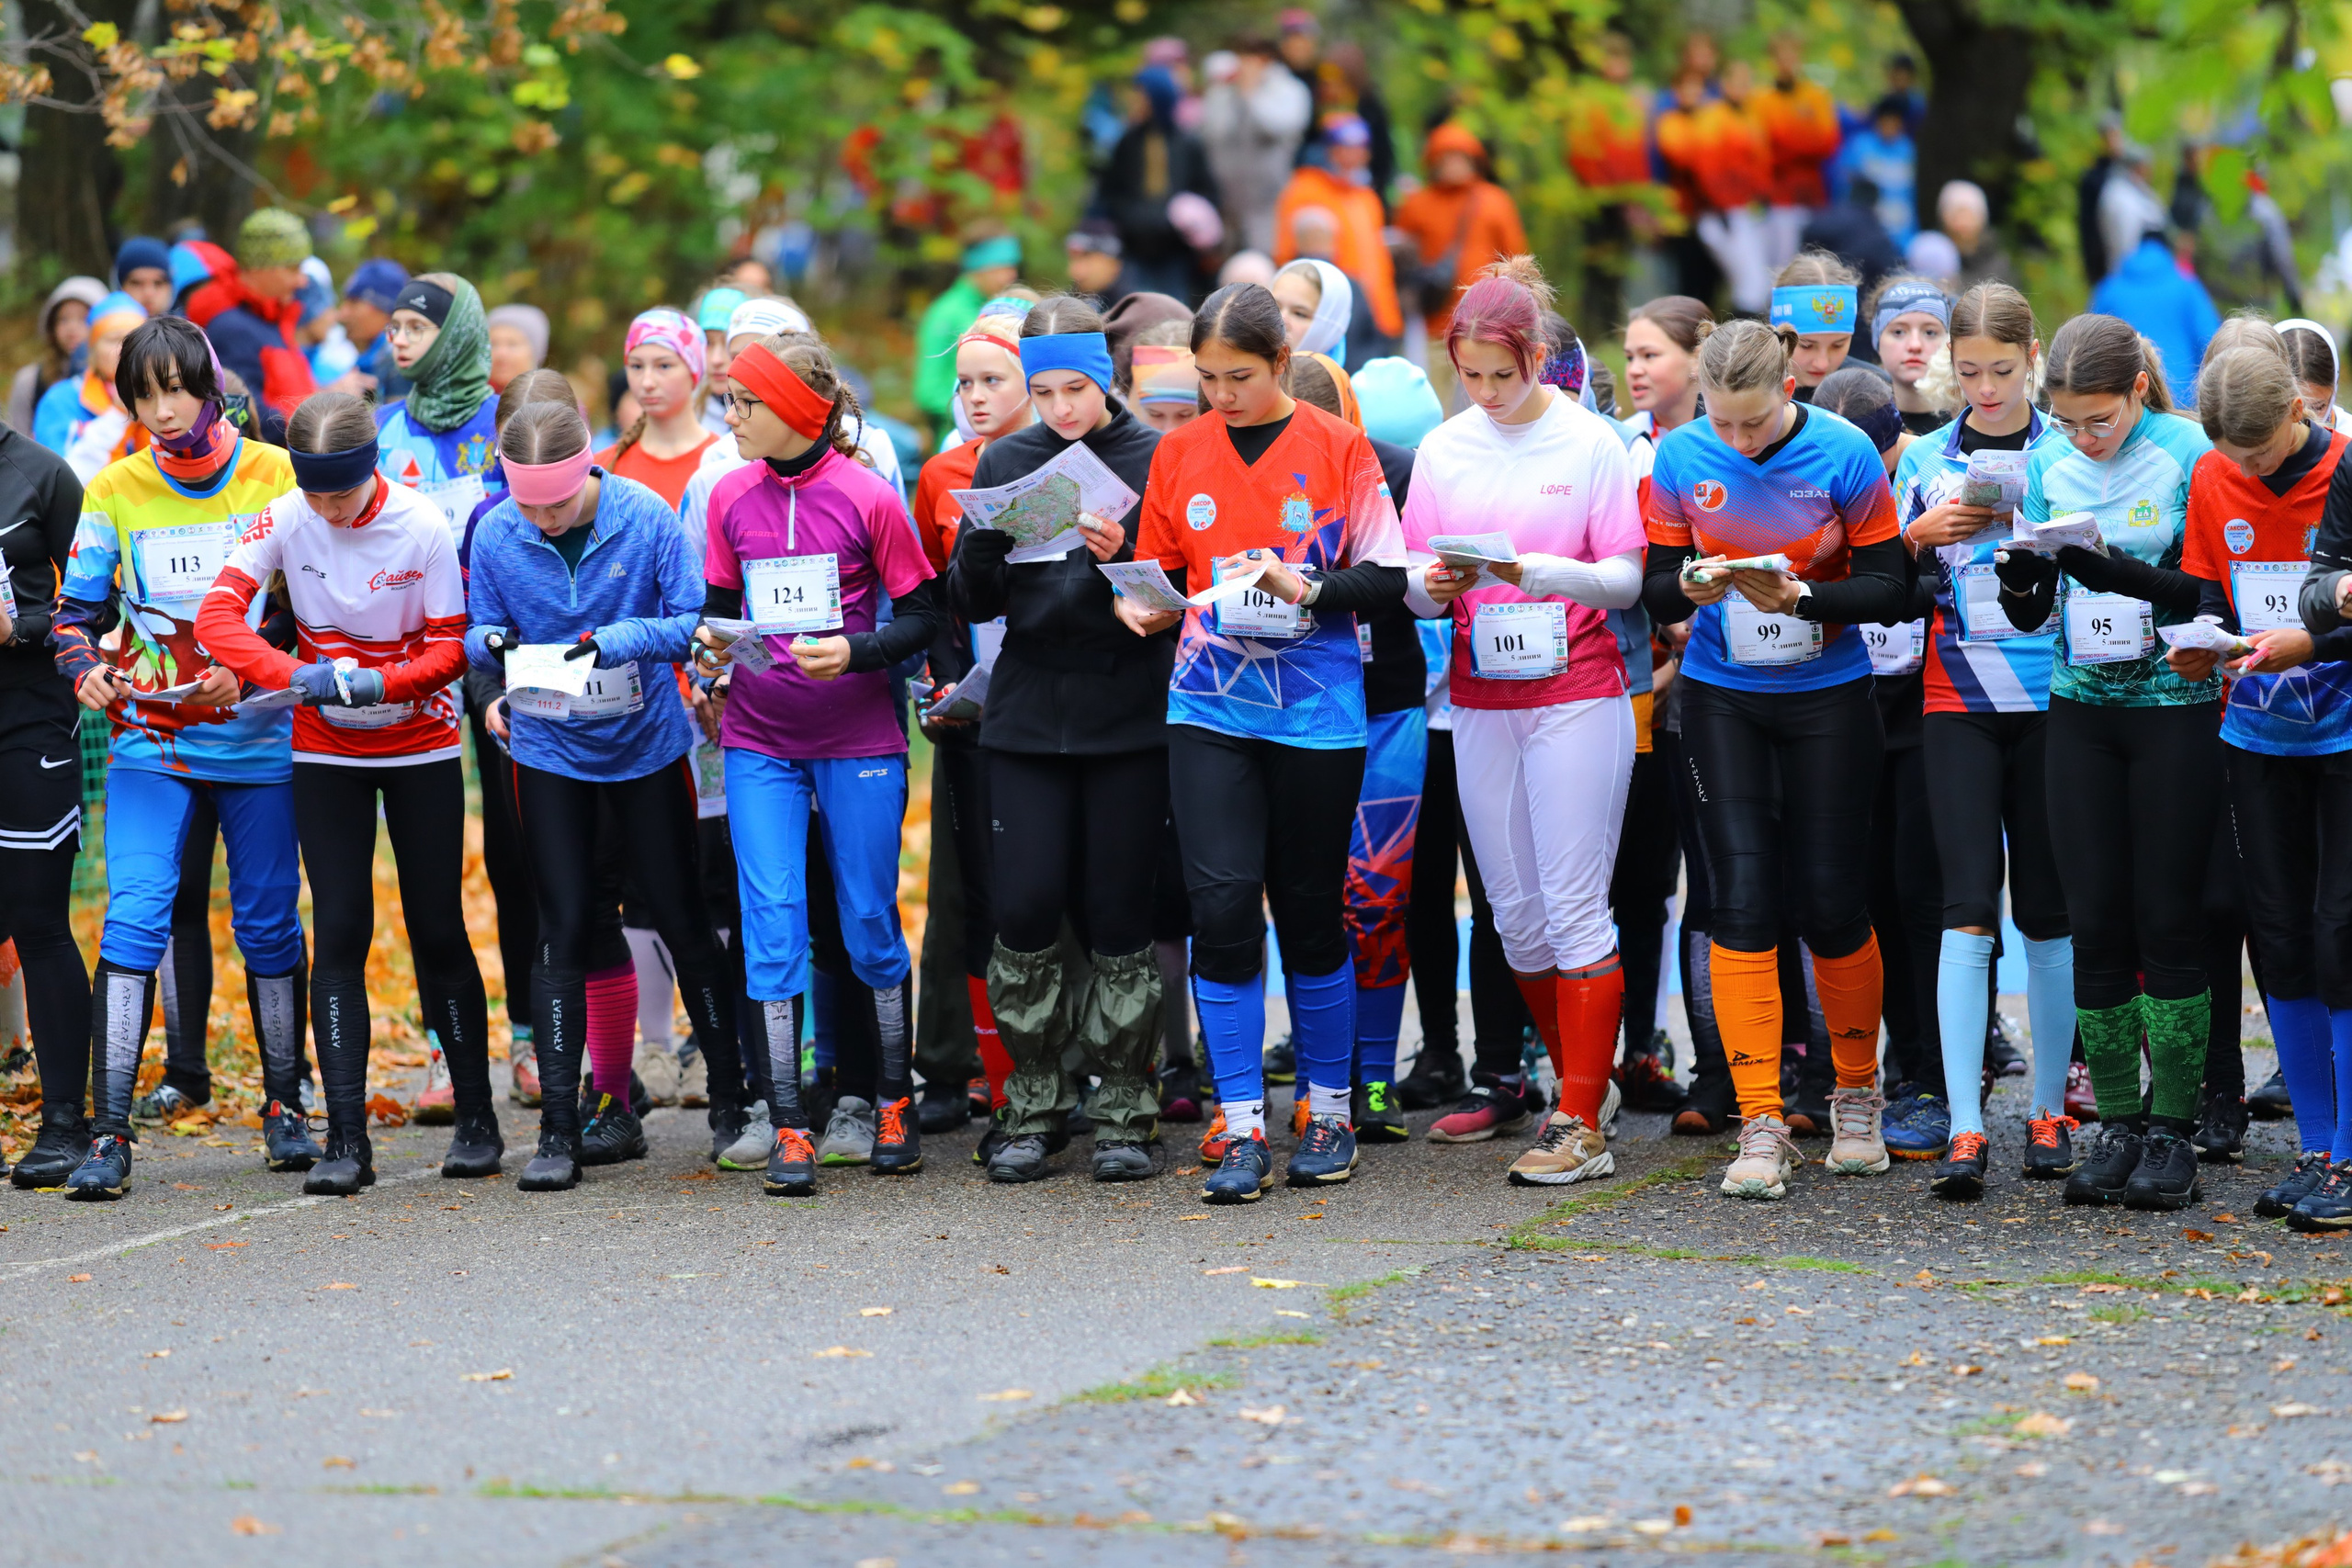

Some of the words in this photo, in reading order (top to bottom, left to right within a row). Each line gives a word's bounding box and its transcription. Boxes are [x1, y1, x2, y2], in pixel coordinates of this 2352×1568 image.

[170, 556, 201, 573] 113
[773, 586, 804, 604] 124
[1243, 590, 1275, 608] 104
[2265, 594, 2288, 613] 93
[1758, 623, 1781, 642] 99
[2092, 618, 2112, 636] 95
[1493, 634, 1525, 652] 101
[1860, 630, 1887, 648] 39
[586, 681, 603, 695] 11
[537, 700, 561, 710] 111.2
[589, 711, 623, 719] СОРЕВНОВАНИЯ
[858, 768, 888, 777] ars
[329, 996, 340, 1048] ARSWEAR
[552, 999, 563, 1052] ARSWEAR
